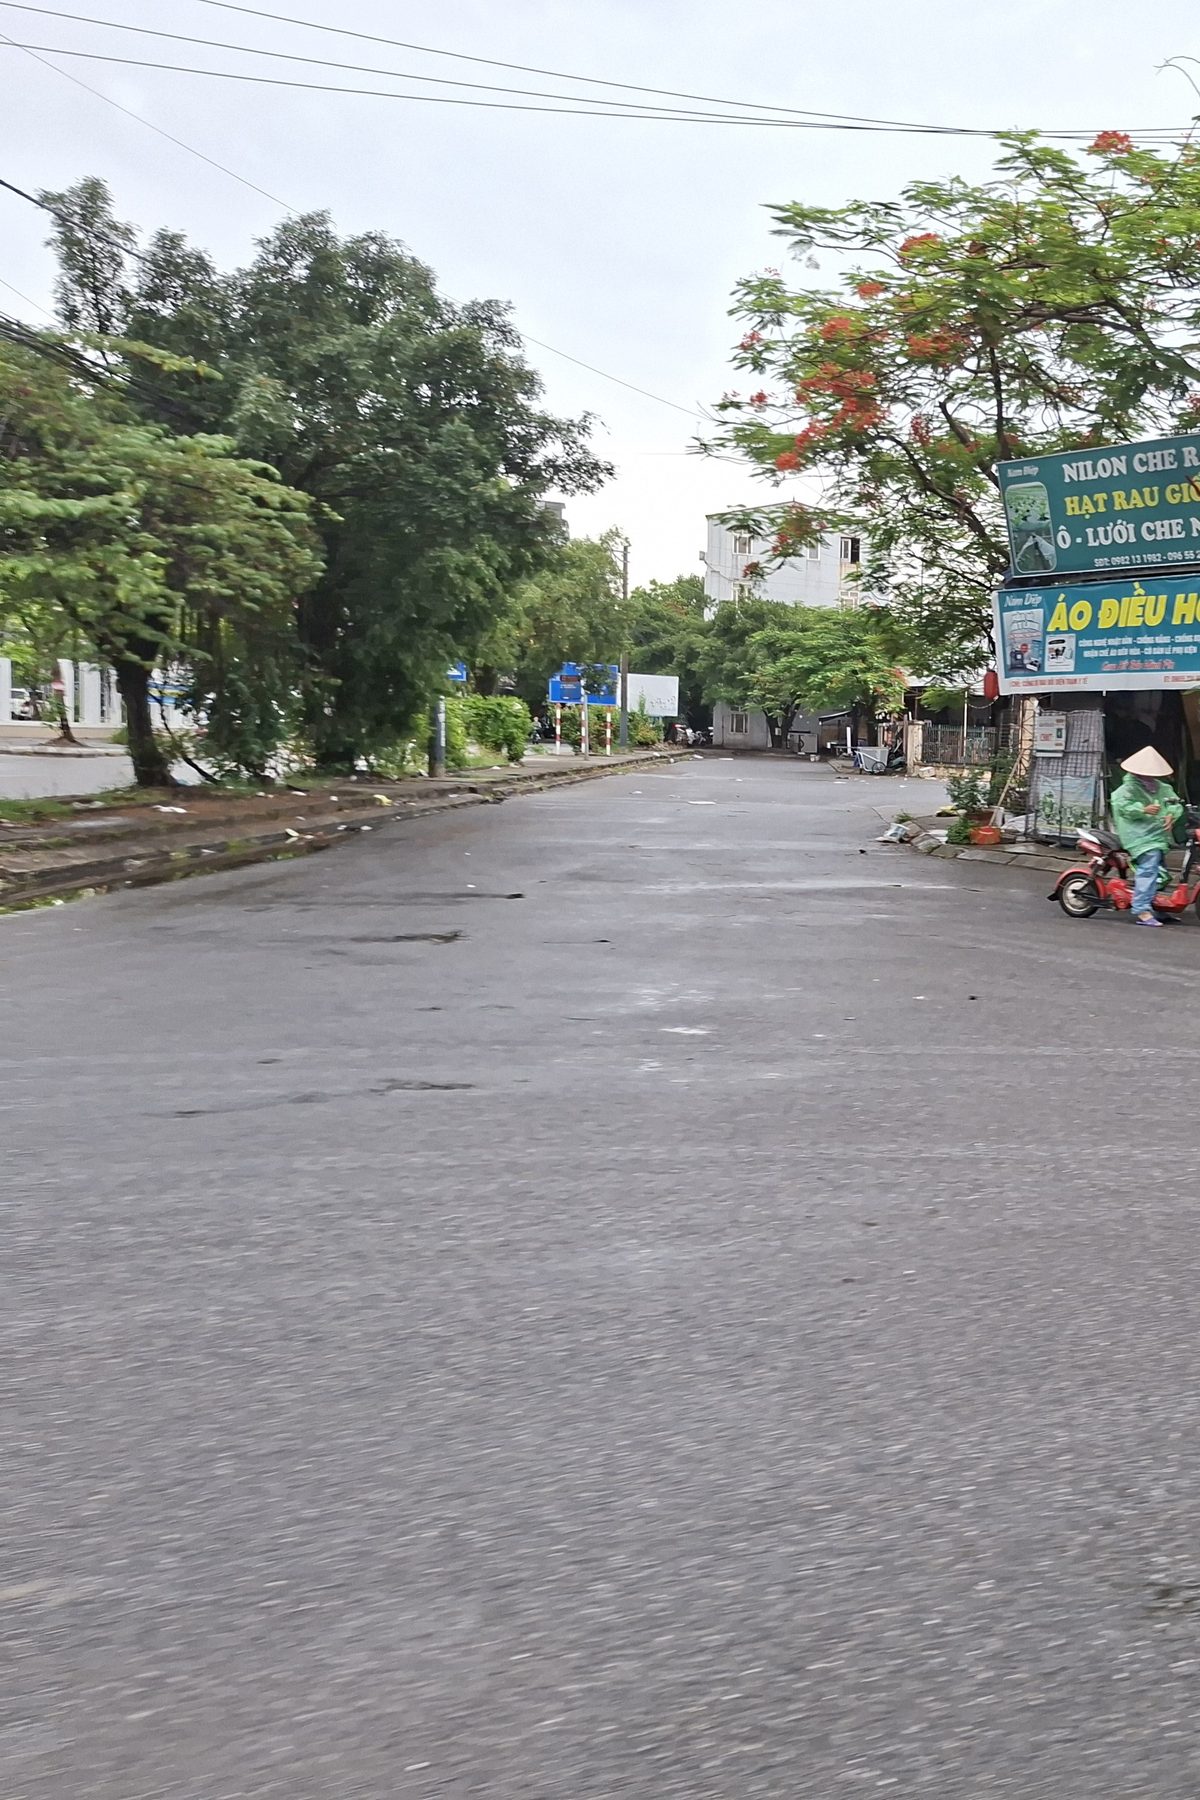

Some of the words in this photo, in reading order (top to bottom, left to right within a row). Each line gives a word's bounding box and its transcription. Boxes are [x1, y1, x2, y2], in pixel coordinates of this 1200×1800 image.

[1062, 456, 1127, 483] NILON
[1133, 449, 1178, 473] CHE
[1064, 493, 1108, 519] HẠT
[1112, 486, 1159, 511] RAU
[1057, 525, 1071, 549] Ô
[1086, 519, 1136, 547] LƯỚI
[1141, 516, 1186, 541] CHE
[1110, 555, 1131, 566] 0982
[1131, 554, 1142, 564] 13
[1142, 552, 1163, 564] 1982
[1047, 593, 1093, 632] ÁO
[1098, 581, 1168, 629] ĐIỀU
